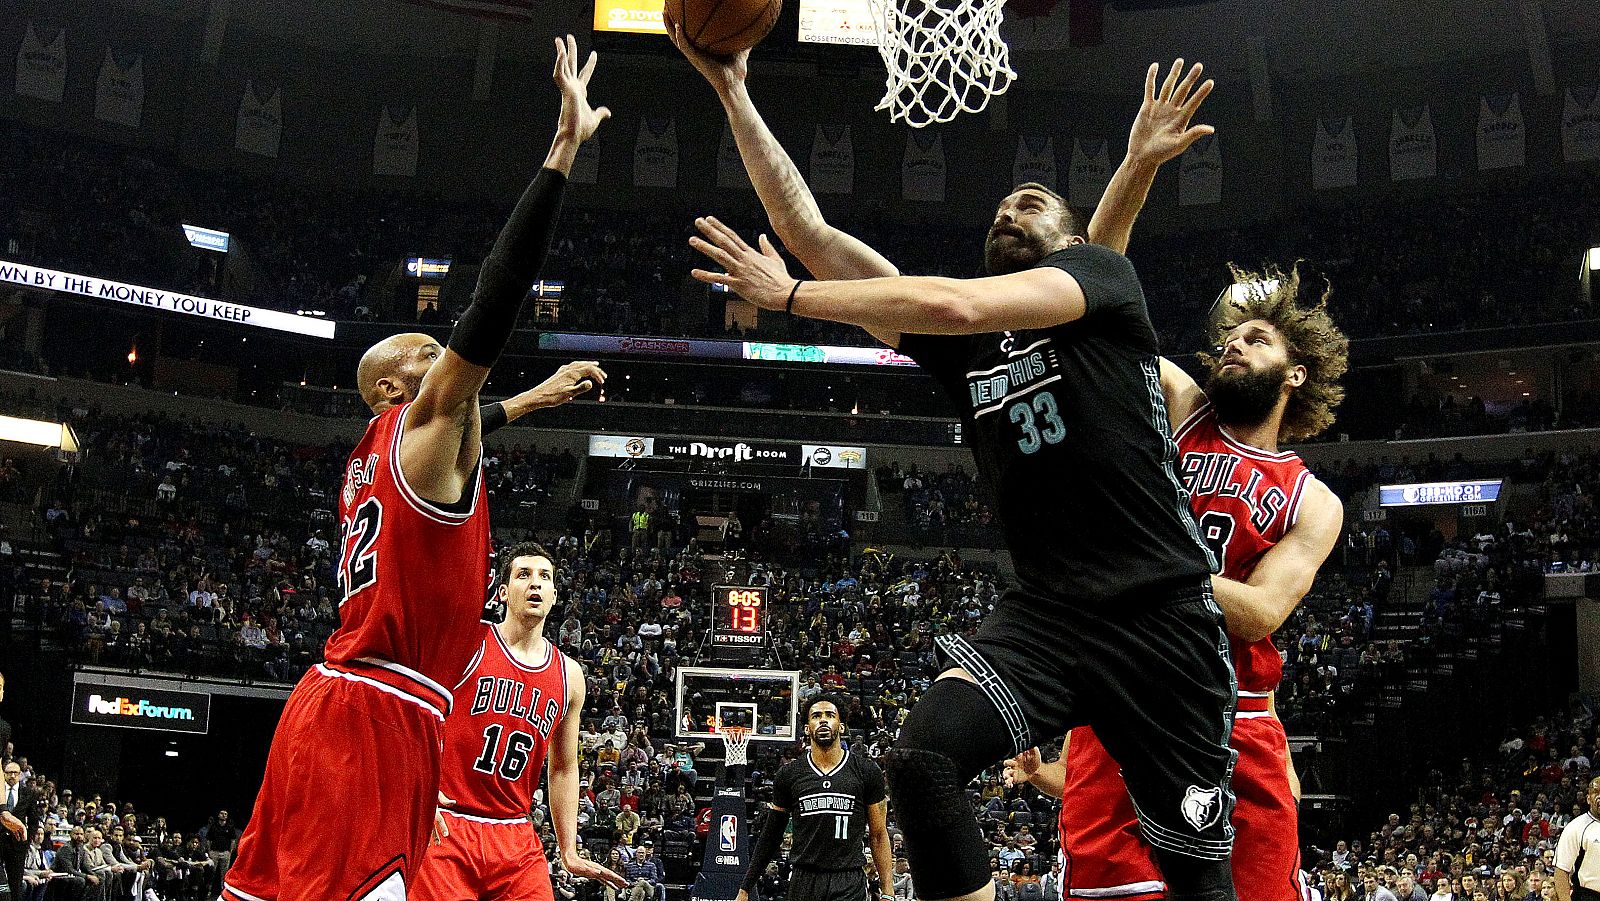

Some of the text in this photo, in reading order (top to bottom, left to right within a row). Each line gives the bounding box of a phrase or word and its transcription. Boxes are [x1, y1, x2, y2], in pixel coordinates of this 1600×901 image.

[34, 271, 56, 287] BY
[63, 276, 93, 294] THE
[99, 284, 165, 307] MONEY
[172, 296, 207, 314] YOU
[213, 304, 251, 322] KEEP
[1008, 391, 1067, 455] 33
[668, 442, 787, 463] THE Draft ROOM
[690, 479, 761, 490] GRIZZLIES.COM
[1181, 451, 1288, 536] BULLS
[728, 590, 761, 607] 8:05
[733, 607, 758, 632] 13
[728, 635, 763, 643] TISSOT
[470, 676, 559, 741] BULLS
[473, 723, 535, 782] 16
[802, 797, 851, 812] MEMPHIS
[834, 815, 849, 840] 11
[715, 855, 740, 866] @NBA
